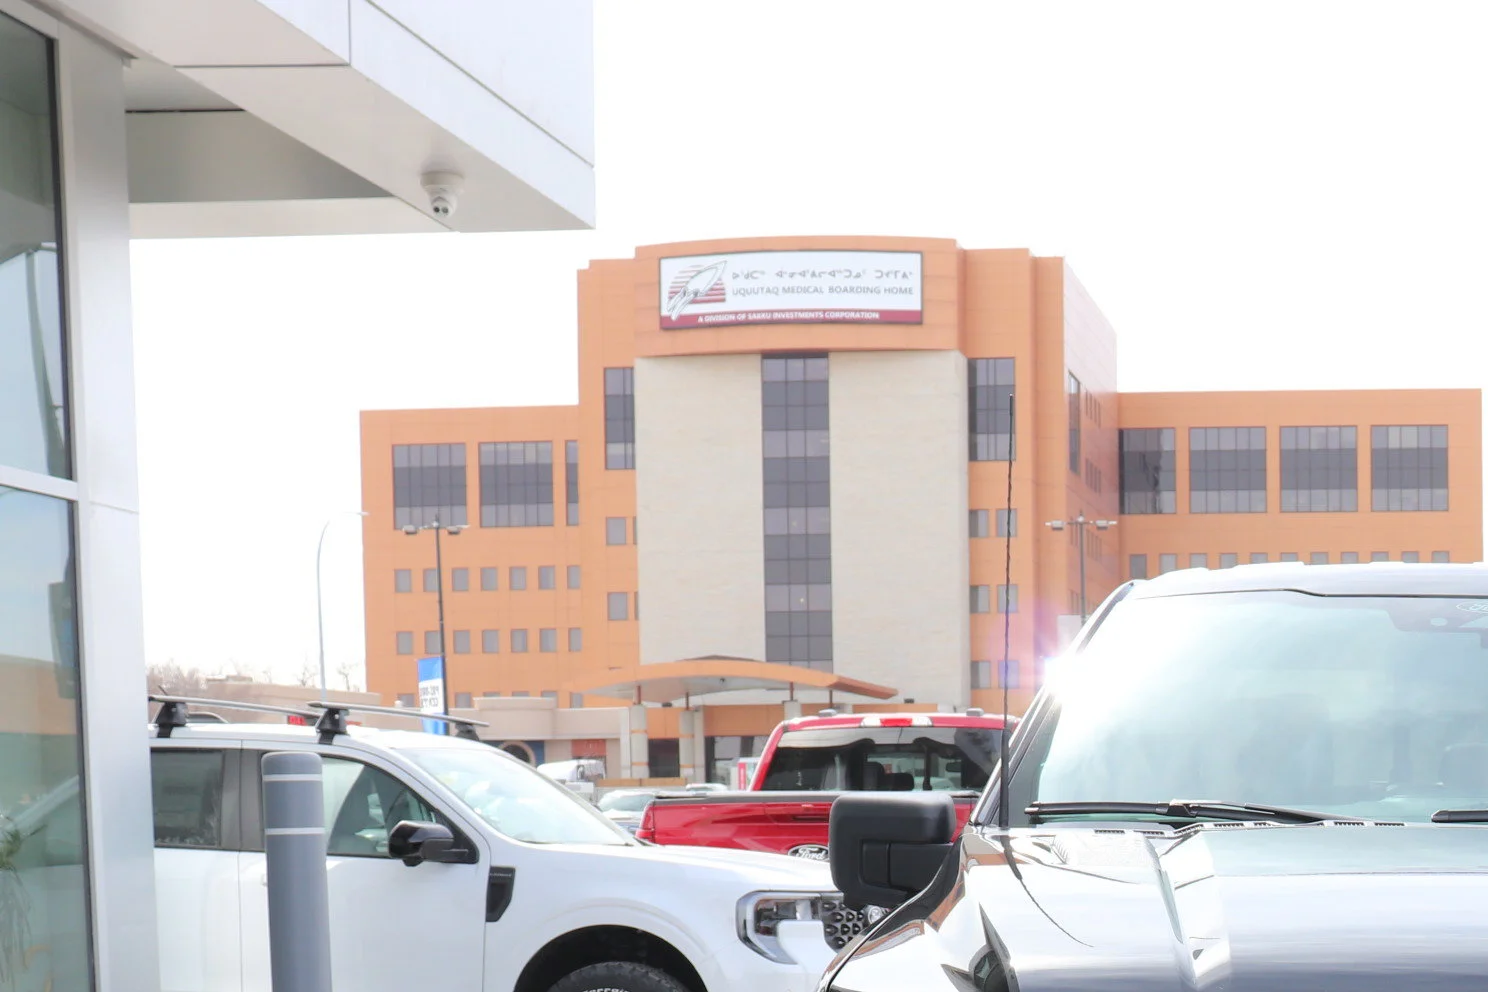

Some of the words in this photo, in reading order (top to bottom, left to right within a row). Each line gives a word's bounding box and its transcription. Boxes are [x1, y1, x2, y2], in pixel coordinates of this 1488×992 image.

[732, 286, 779, 297] UQUUTAQ
[782, 285, 825, 294] MEDICAL
[828, 285, 881, 294] BOARDING
[884, 286, 914, 295] HOME
[704, 313, 735, 322] DIVISION
[773, 311, 824, 319] INVESTMENTS
[825, 311, 880, 319] CORPORATION
